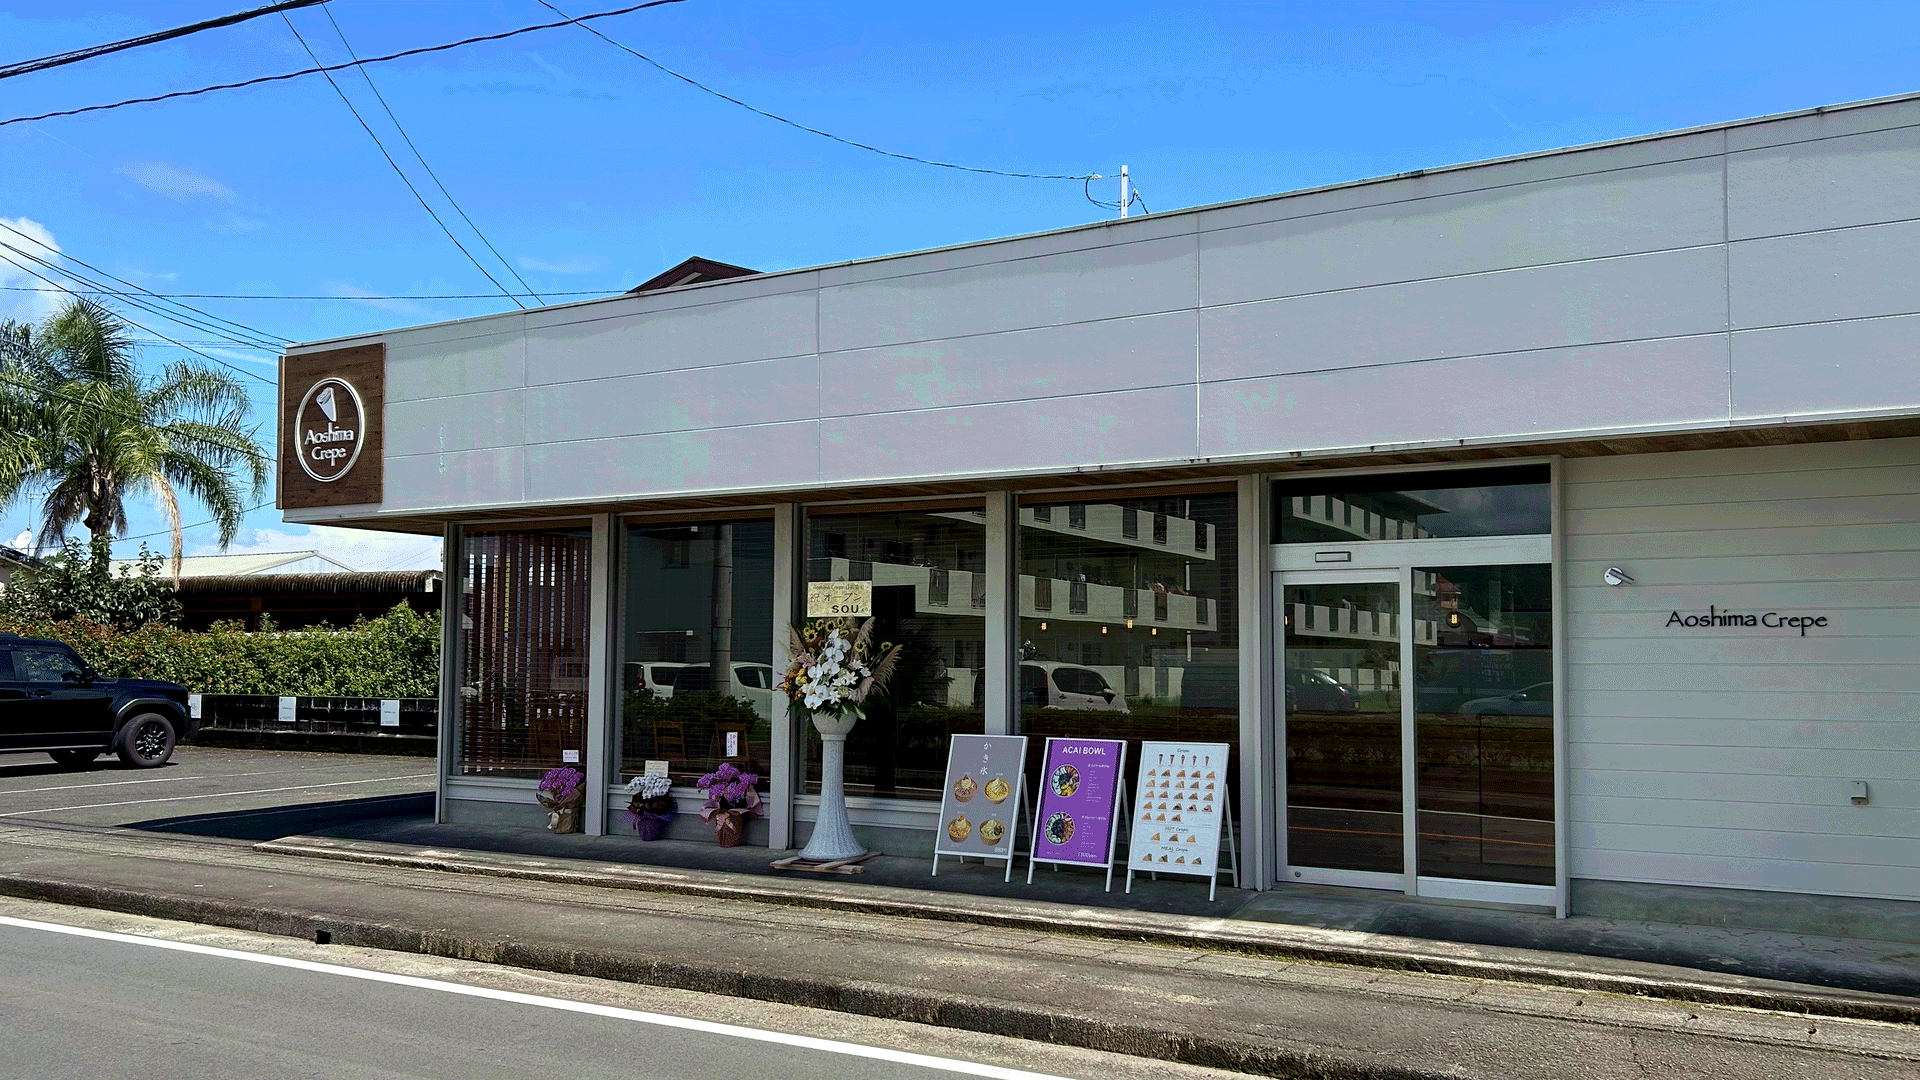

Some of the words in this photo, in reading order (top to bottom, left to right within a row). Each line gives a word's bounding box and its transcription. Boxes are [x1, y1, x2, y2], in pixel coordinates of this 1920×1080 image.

[304, 422, 355, 445] Aoshima
[311, 446, 347, 467] Crepe
[824, 592, 862, 602] オープン
[831, 604, 859, 614] SOU
[1665, 605, 1757, 628] Aoshima
[1761, 612, 1828, 637] Crepe
[979, 741, 992, 776] かき氷
[1062, 746, 1082, 755] ACAI
[1083, 747, 1107, 756] BOWL
